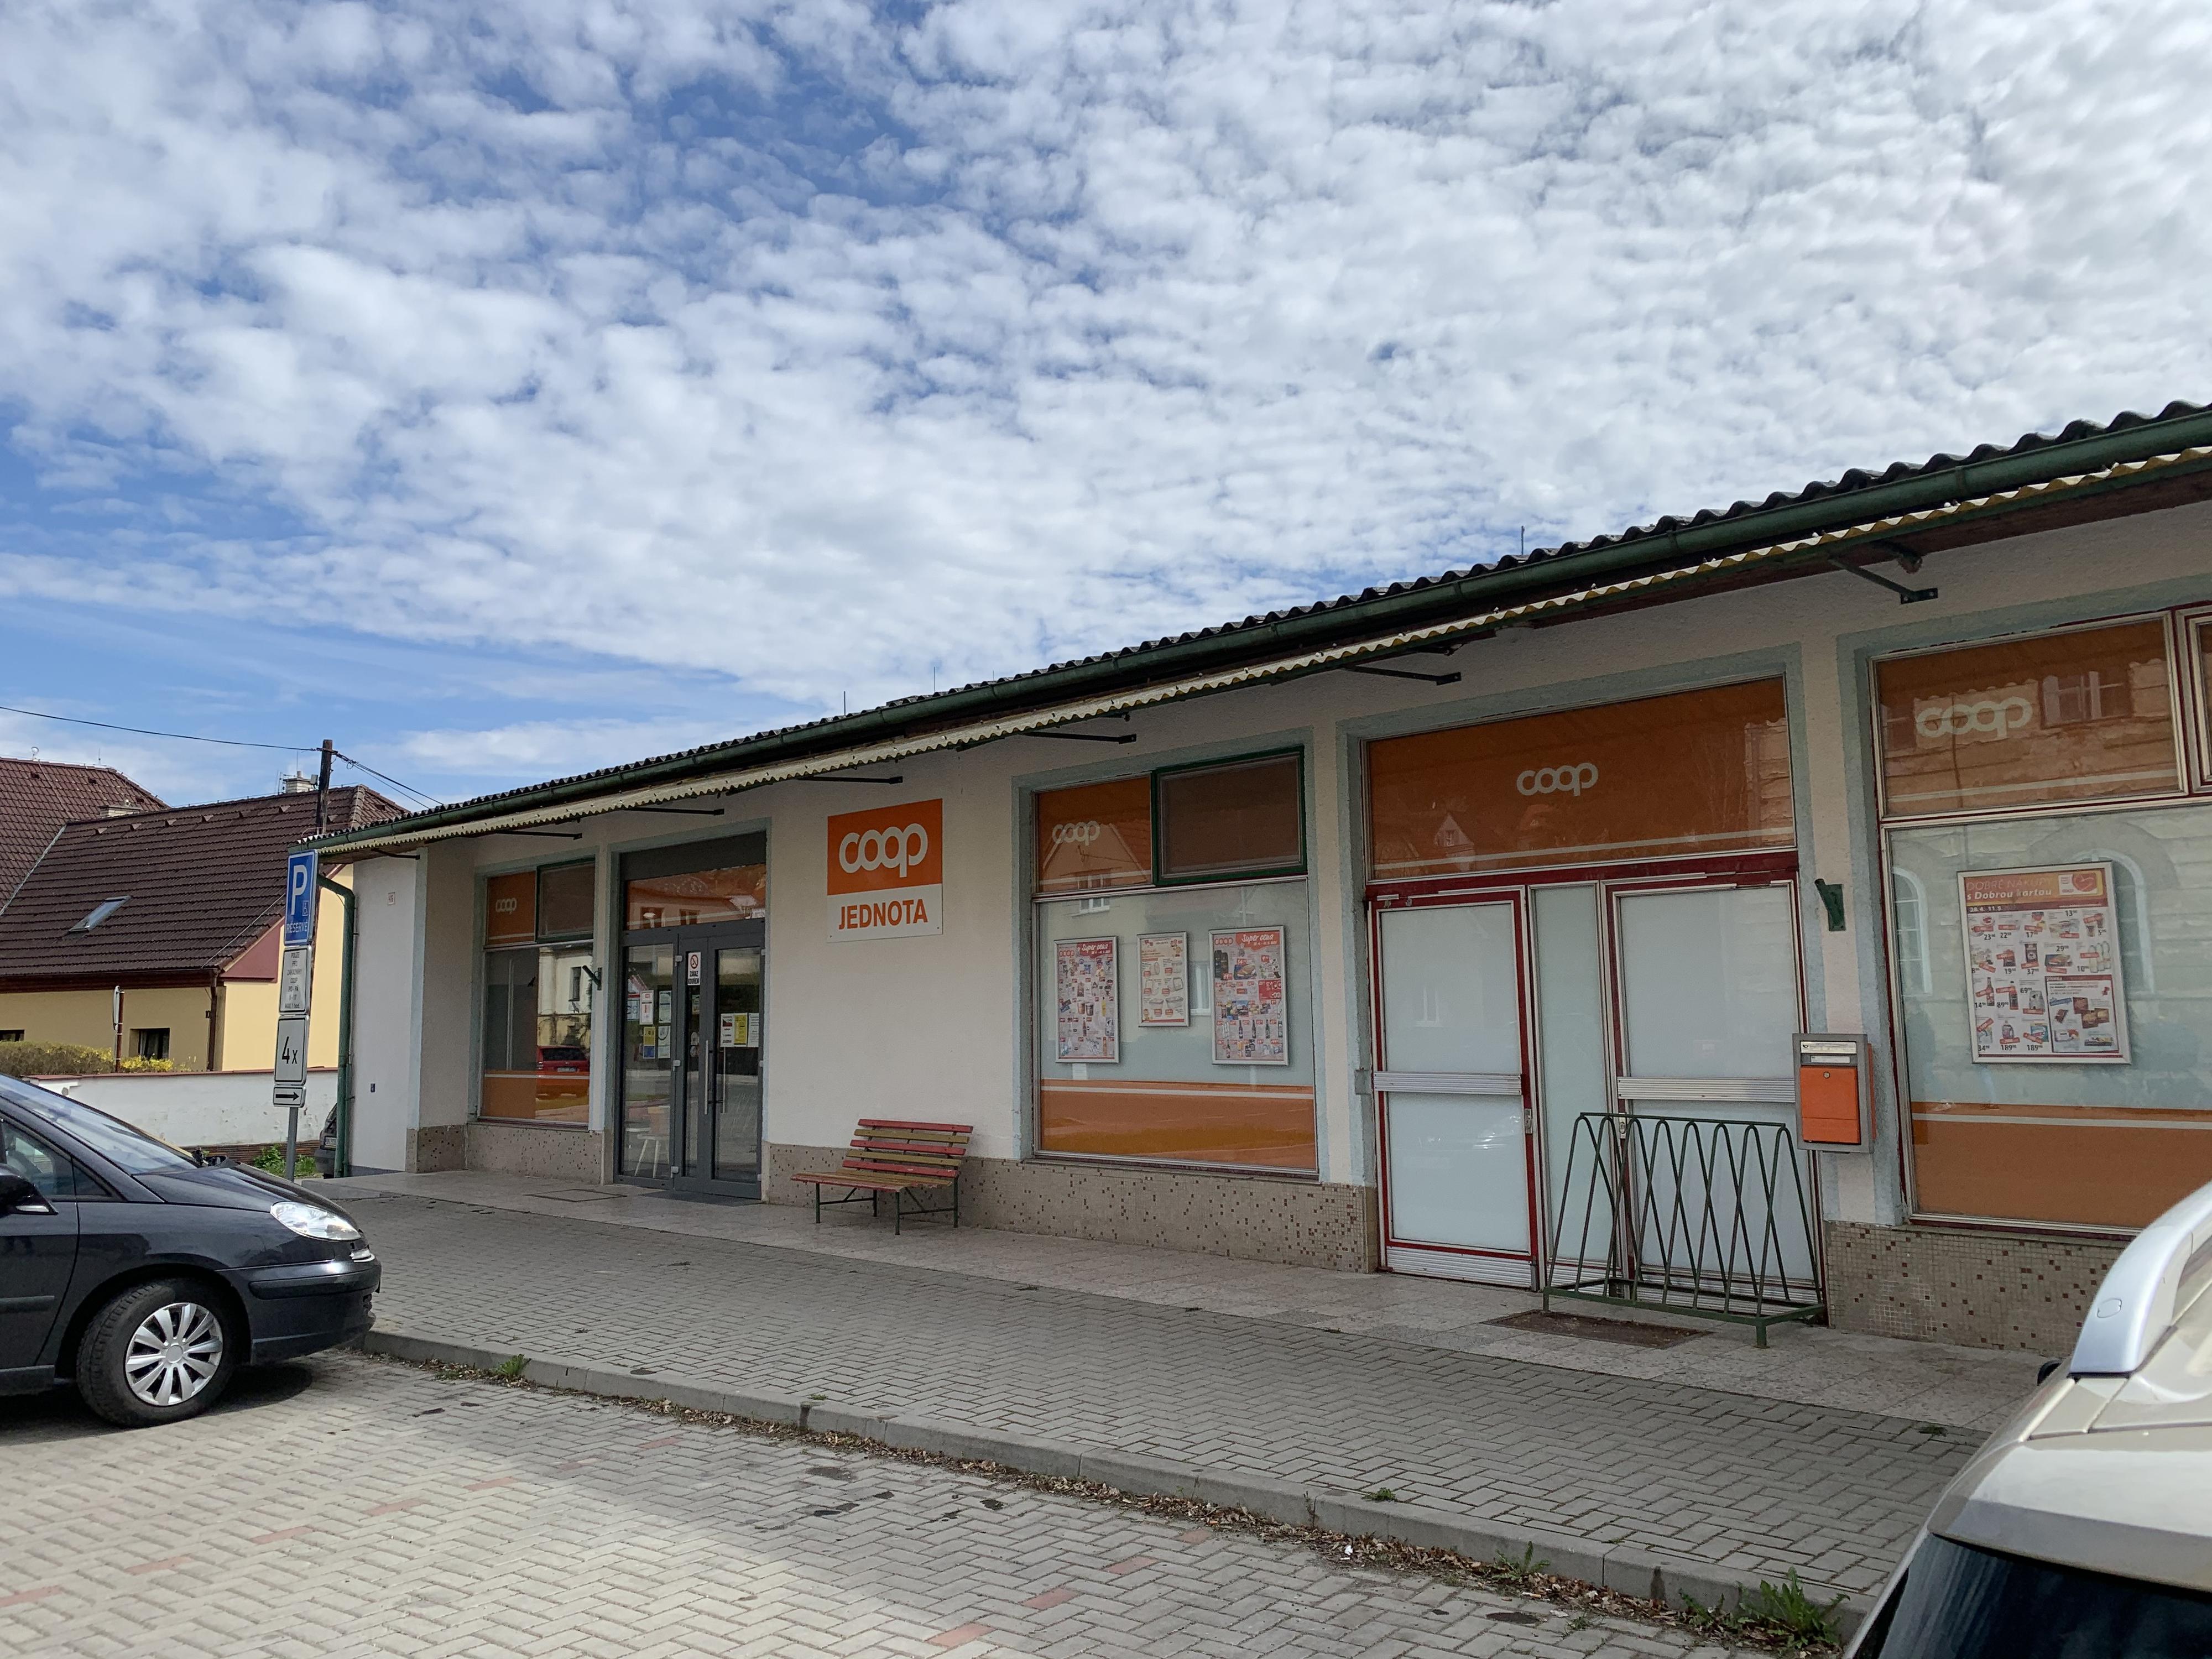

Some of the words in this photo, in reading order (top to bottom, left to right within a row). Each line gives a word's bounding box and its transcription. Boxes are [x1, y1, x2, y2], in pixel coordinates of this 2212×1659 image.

[1916, 696, 2033, 738] coop
[1516, 762, 1599, 796] coop
[1052, 821, 1100, 846] coop
[839, 823, 928, 878] coop
[291, 864, 307, 915] P
[1975, 891, 2013, 900] Dobrou
[495, 898, 517, 915] coop
[838, 899, 928, 930] JEDNOTA
